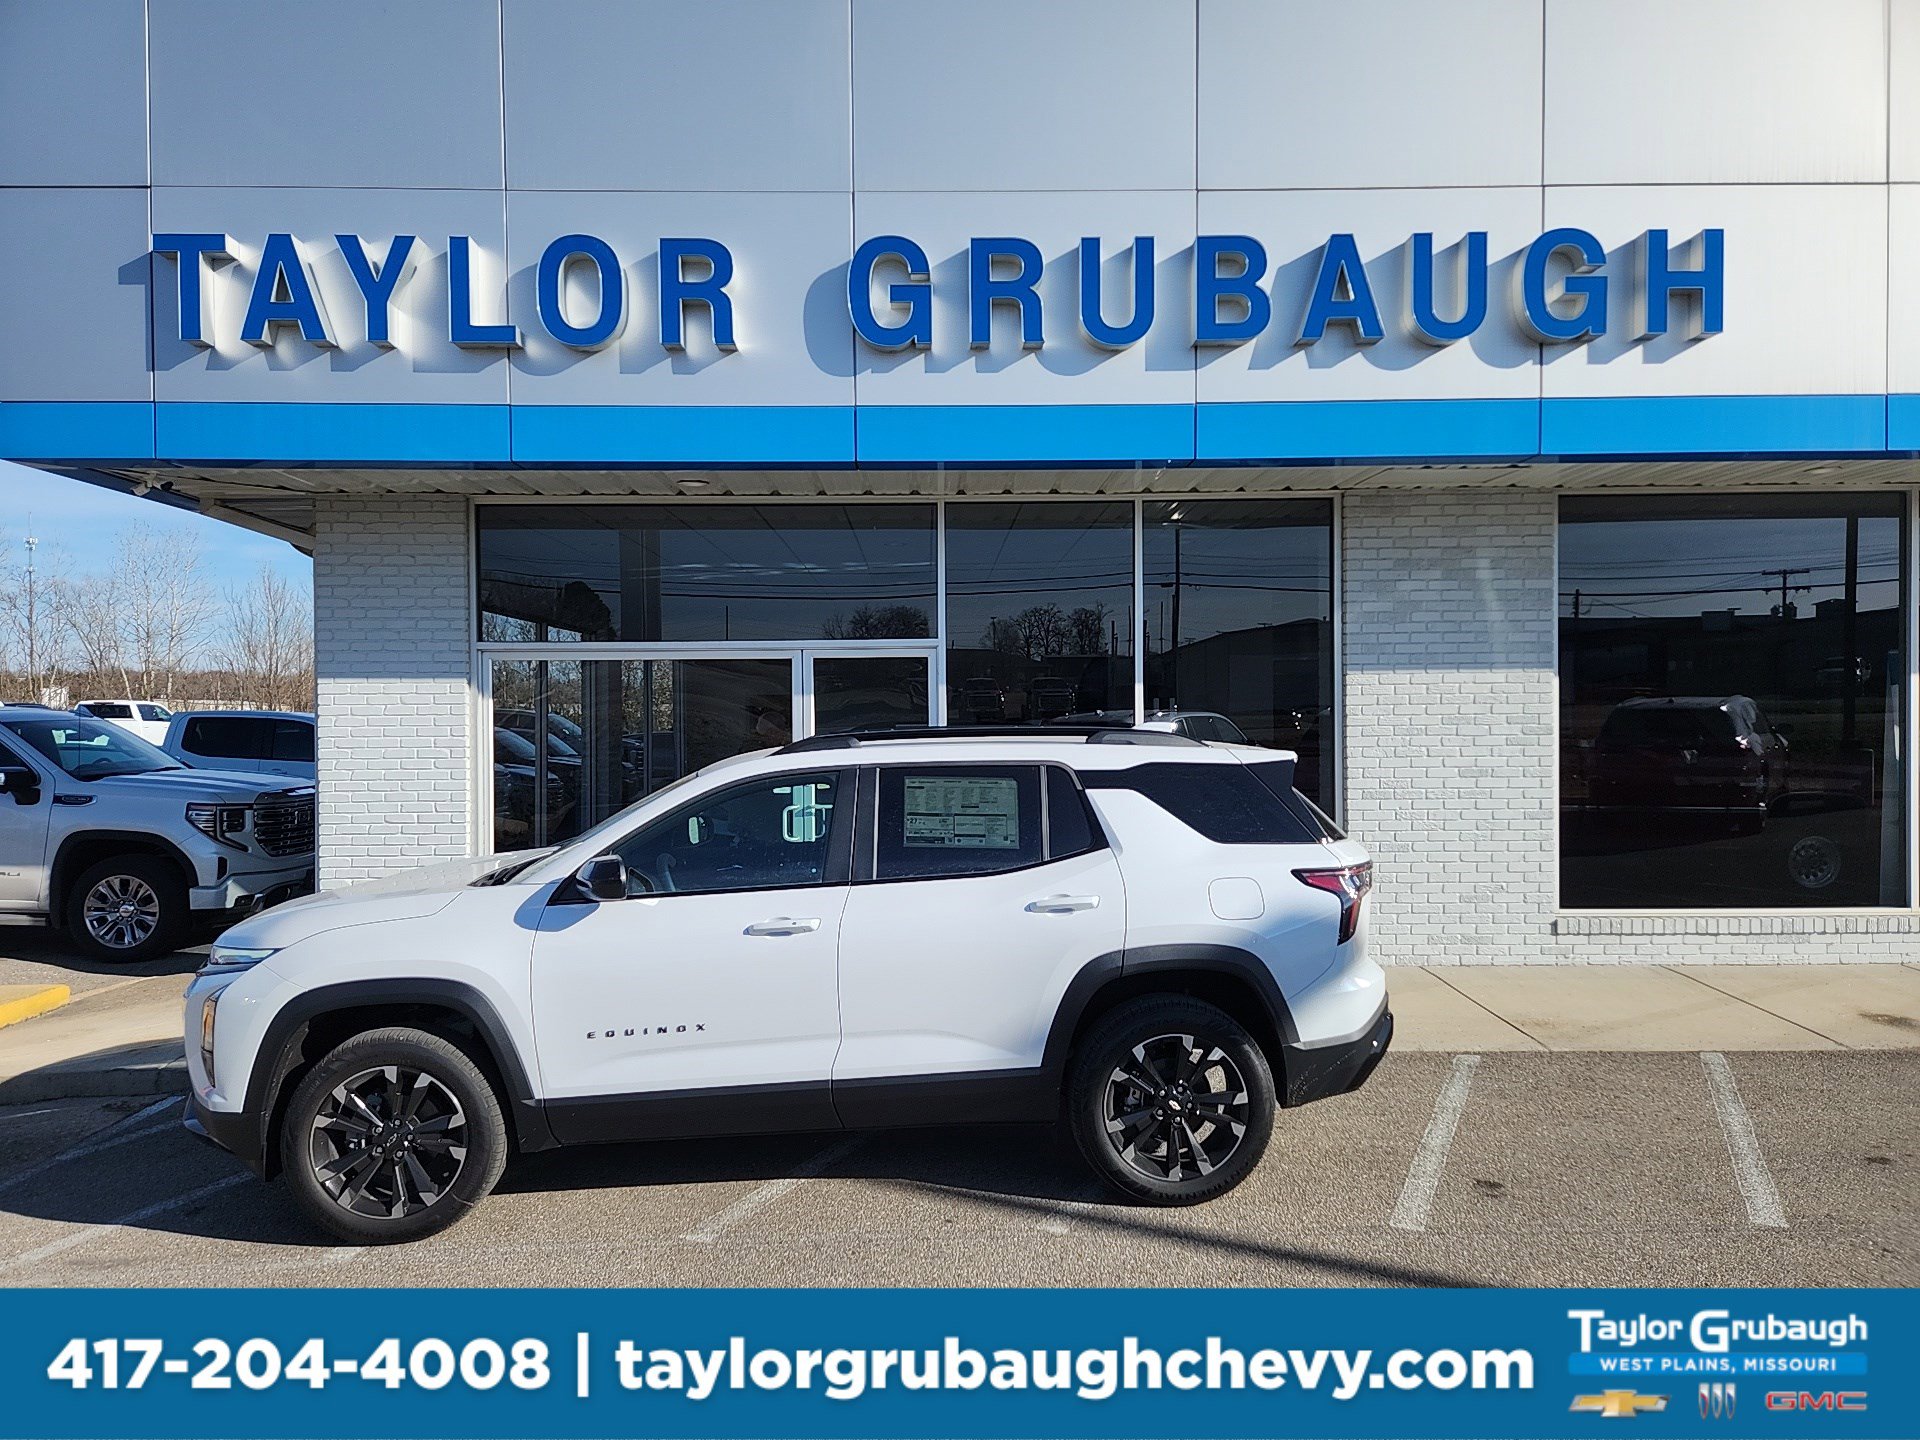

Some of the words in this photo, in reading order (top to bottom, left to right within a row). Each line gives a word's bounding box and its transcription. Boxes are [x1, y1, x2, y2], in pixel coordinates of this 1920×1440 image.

[152, 233, 738, 352] TAYLOR
[846, 228, 1725, 352] GRUBAUGH
[586, 1023, 706, 1039] EQUINOX
